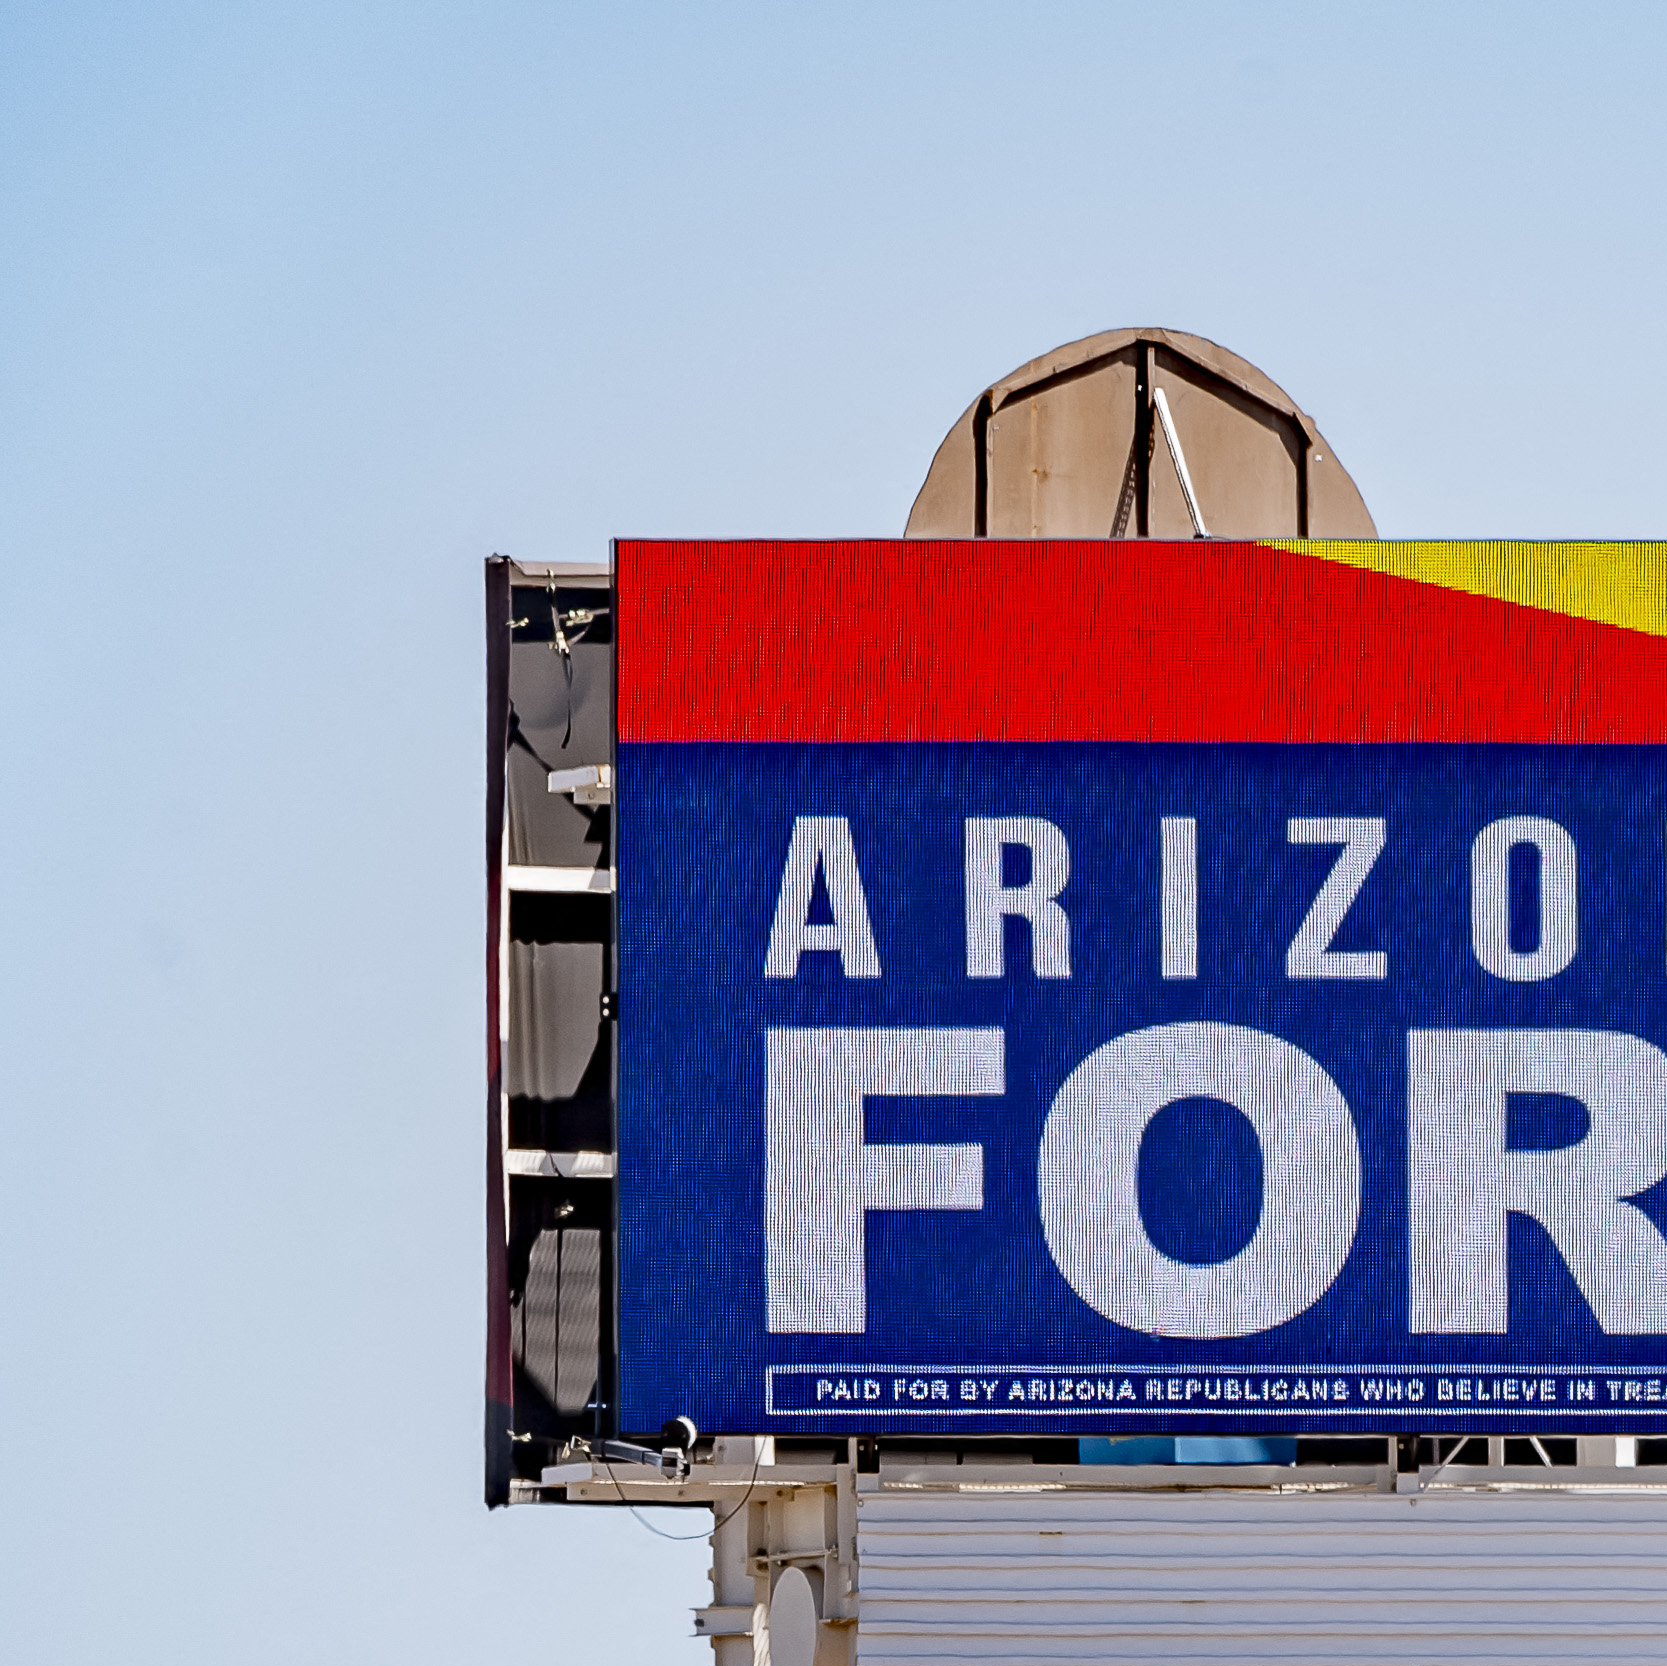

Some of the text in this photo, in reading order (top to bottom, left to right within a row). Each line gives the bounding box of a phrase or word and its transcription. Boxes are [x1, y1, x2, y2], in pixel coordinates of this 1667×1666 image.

[817, 1378, 882, 1401] PAID
[893, 1378, 951, 1401] FOR
[960, 1379, 999, 1401] BY
[1008, 1379, 1137, 1402] ARIZONA
[1145, 1379, 1351, 1402] REPUBLICANS
[1359, 1378, 1426, 1402] WHO
[1437, 1379, 1558, 1402] BELIEVE
[1569, 1379, 1595, 1401] IN
